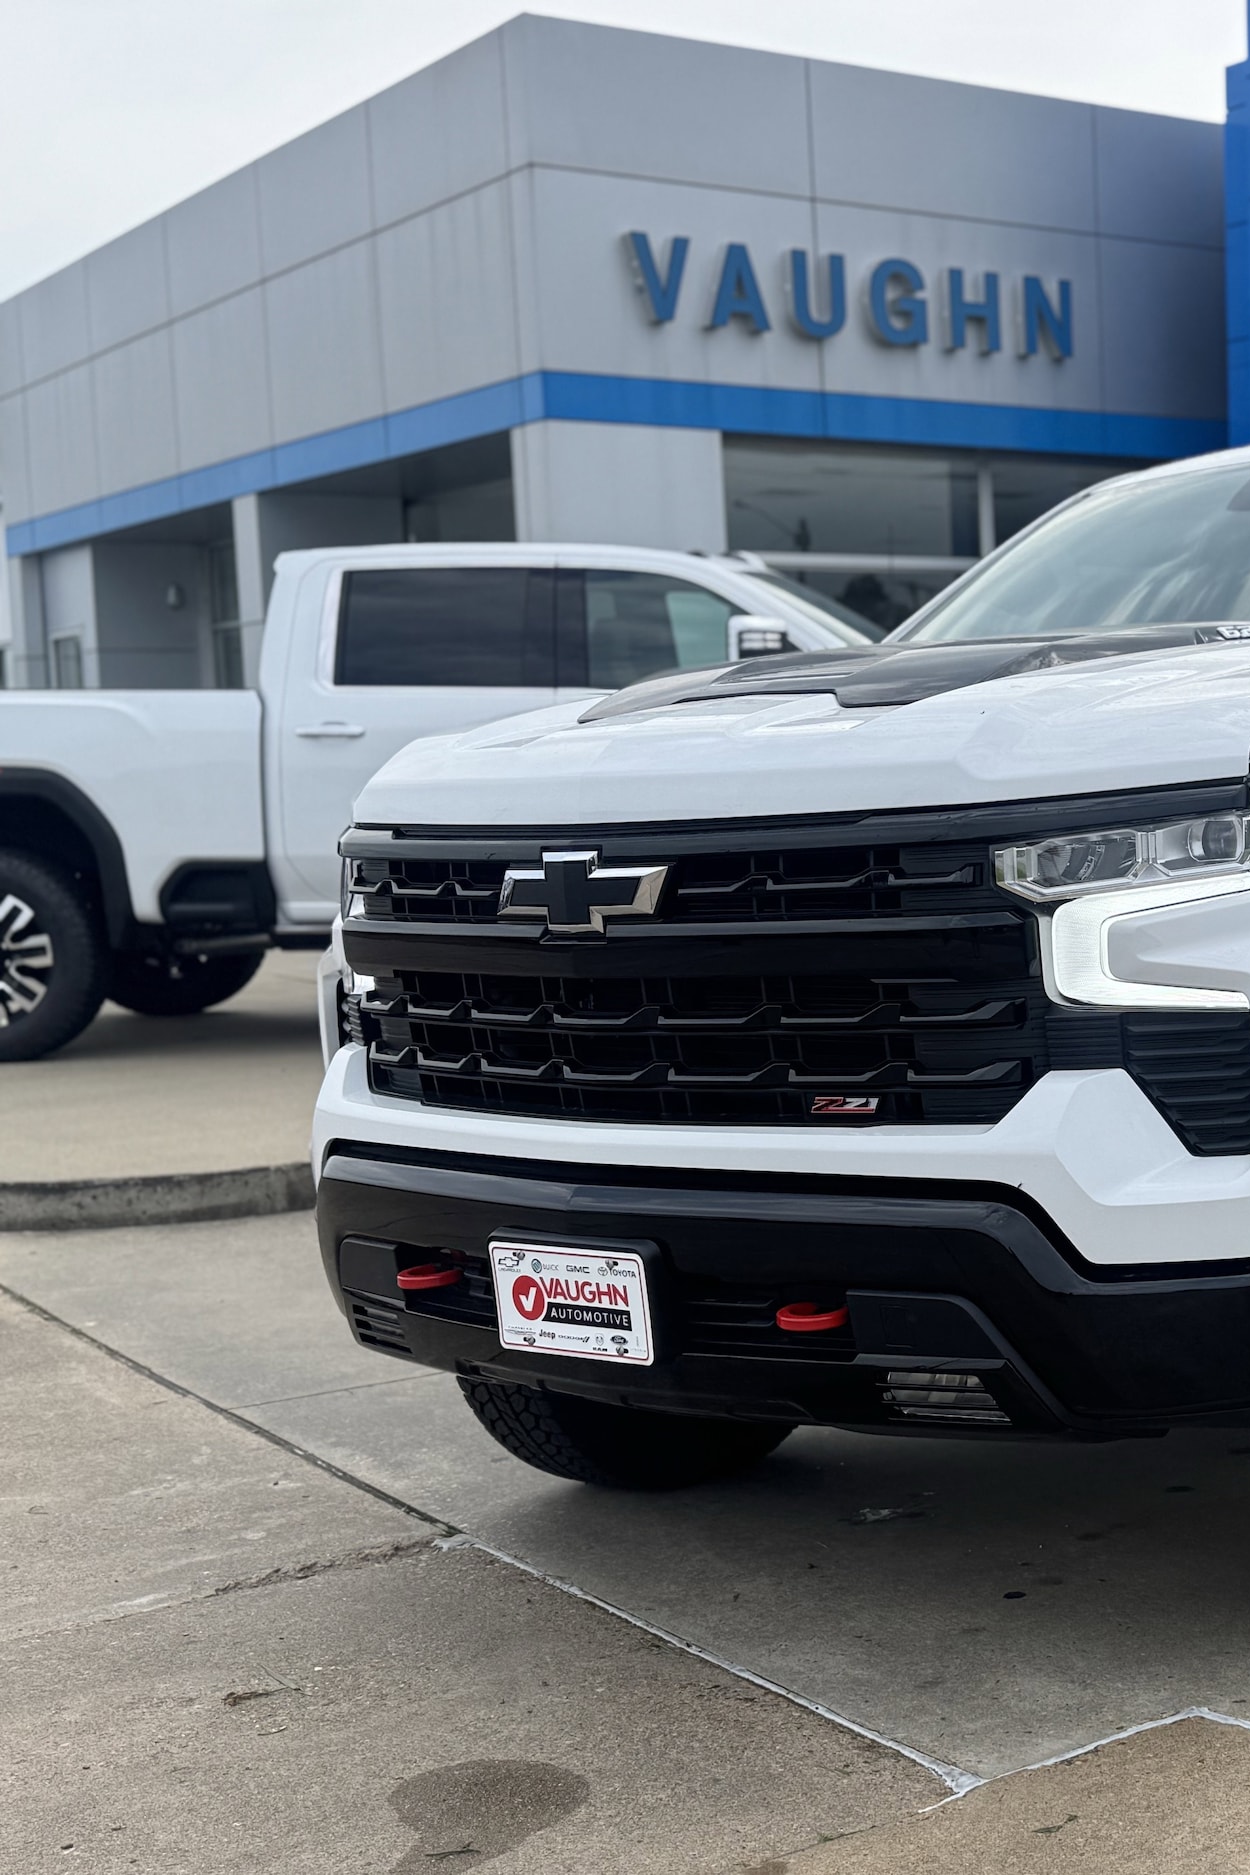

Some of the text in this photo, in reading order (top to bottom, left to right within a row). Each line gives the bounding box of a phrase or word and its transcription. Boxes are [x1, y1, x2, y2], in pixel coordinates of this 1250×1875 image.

[622, 230, 1074, 361] VAUGHN
[811, 1096, 880, 1114] Z71
[565, 1265, 590, 1274] GMC
[539, 1276, 630, 1307] VAUGHN
[550, 1307, 630, 1327] AUTOMOTIVE
[539, 1329, 556, 1340] Jeep
